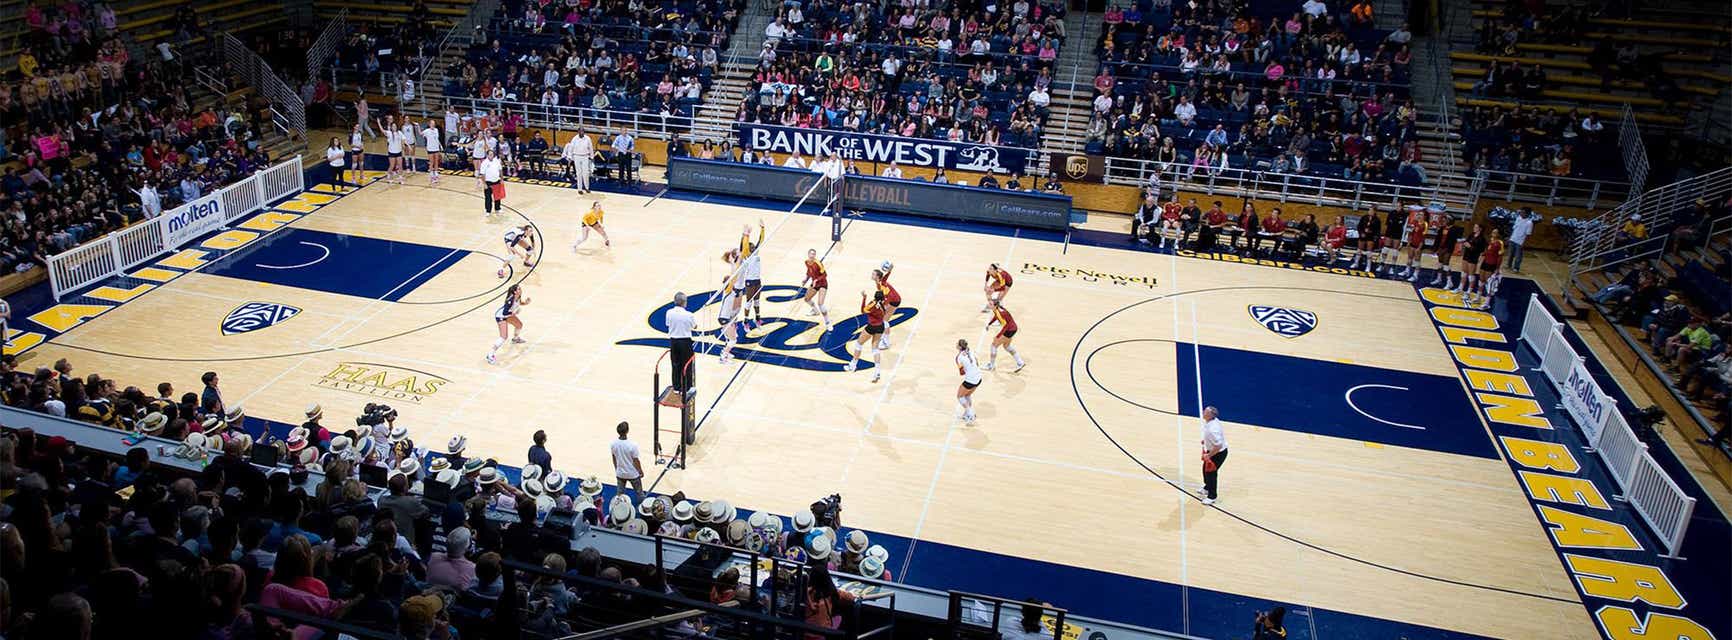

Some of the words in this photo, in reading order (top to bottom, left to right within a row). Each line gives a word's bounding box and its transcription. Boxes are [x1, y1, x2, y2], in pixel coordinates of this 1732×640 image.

[752, 128, 834, 157] BANK
[834, 147, 863, 160] THE
[839, 137, 858, 149] OF
[863, 138, 953, 167] WEST
[1068, 162, 1087, 176] ups
[844, 182, 912, 206] LLEYBALL
[168, 199, 219, 234] molten
[1023, 262, 1070, 275] Pete
[1075, 268, 1158, 286] Newell
[1176, 249, 1376, 279] CalBears.com
[614, 284, 918, 372] Cal
[1418, 287, 1555, 430] GOLDEN
[317, 378, 424, 402] PAVILION
[322, 363, 448, 396] HAAS
[1568, 368, 1602, 424] molten
